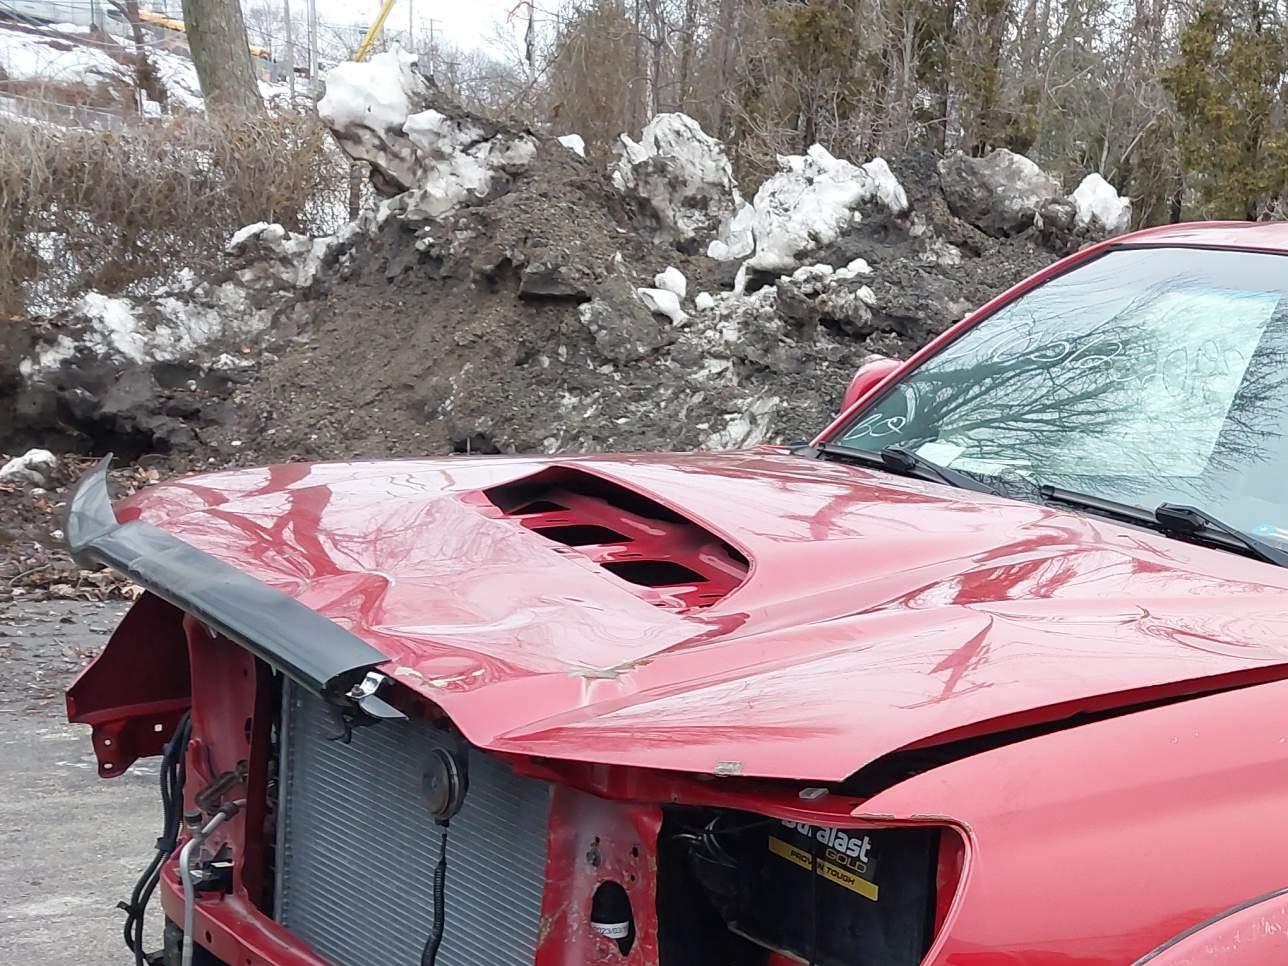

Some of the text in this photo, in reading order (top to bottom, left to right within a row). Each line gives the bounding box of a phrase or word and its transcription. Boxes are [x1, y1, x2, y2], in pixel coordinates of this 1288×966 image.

[790, 849, 856, 886] PROVN TOUGH
[825, 848, 867, 874] GOLD
